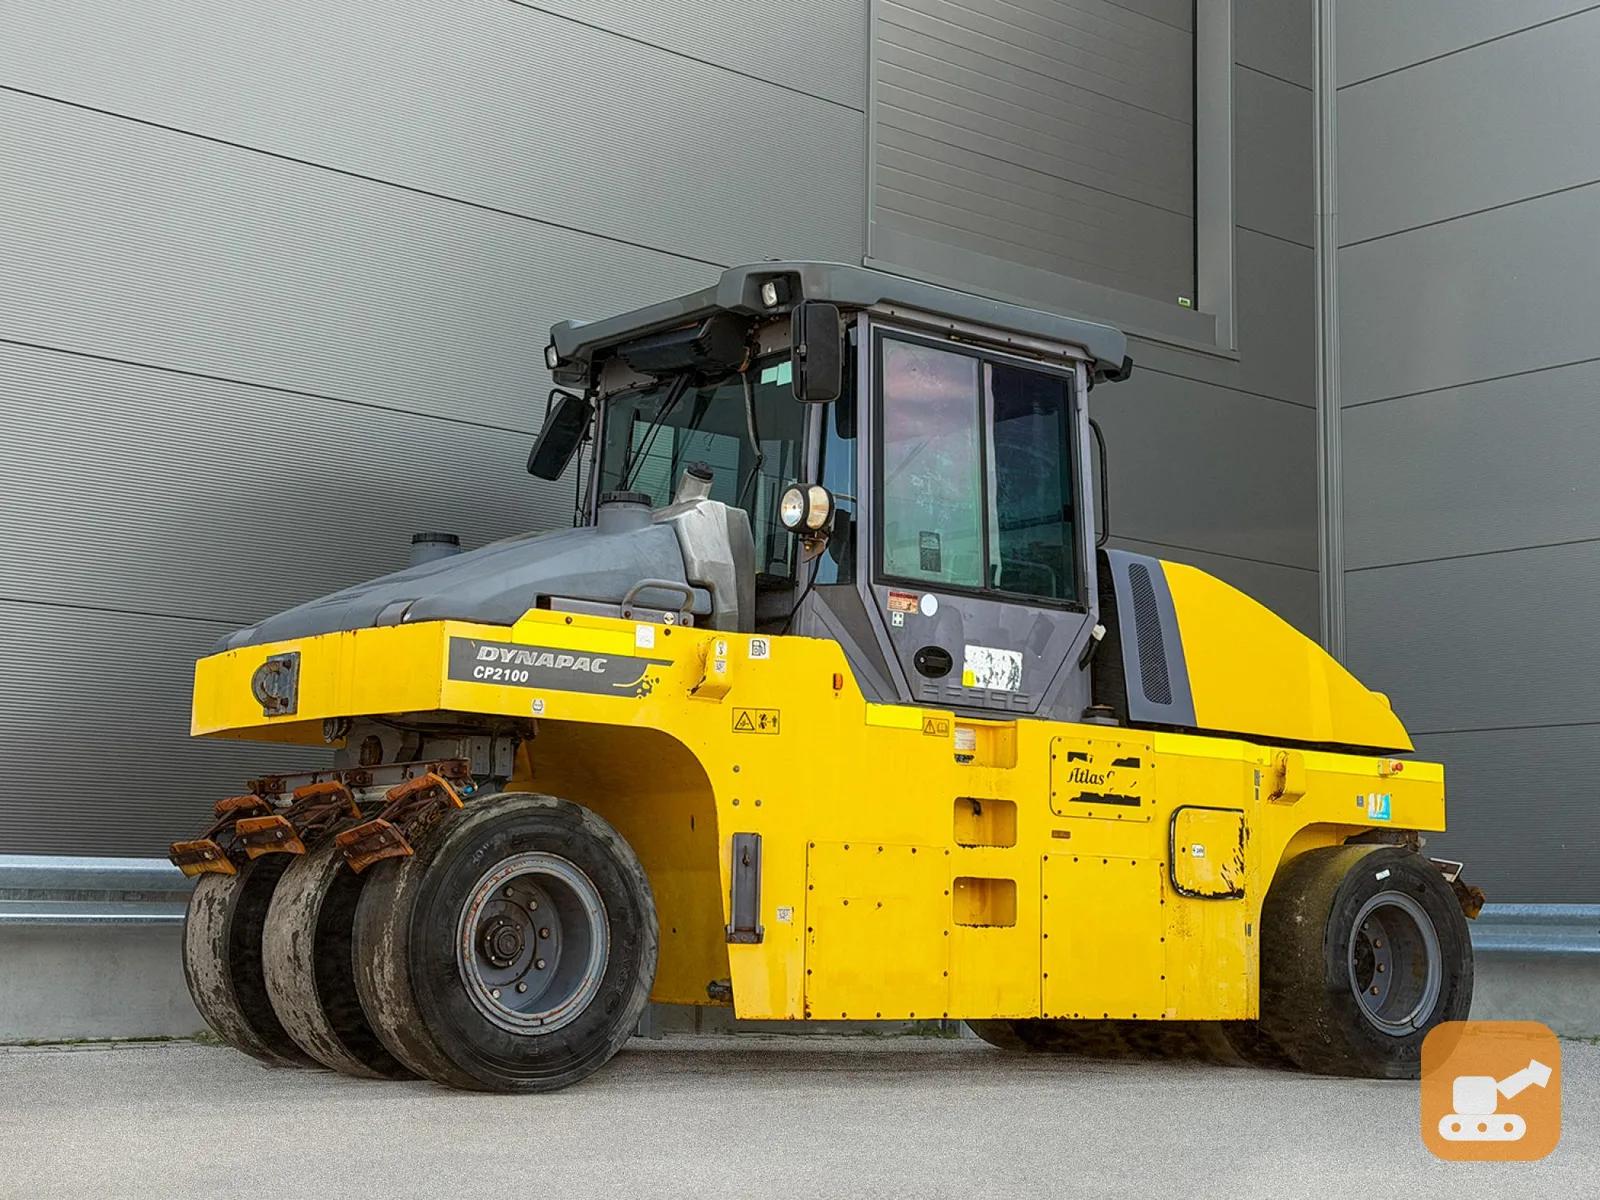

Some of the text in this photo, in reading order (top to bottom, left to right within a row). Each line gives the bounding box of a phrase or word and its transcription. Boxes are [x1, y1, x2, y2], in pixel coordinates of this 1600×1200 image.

[476, 645, 608, 673] DYNAPAC
[473, 665, 529, 683] CP2100
[1067, 767, 1105, 786] Atlas
